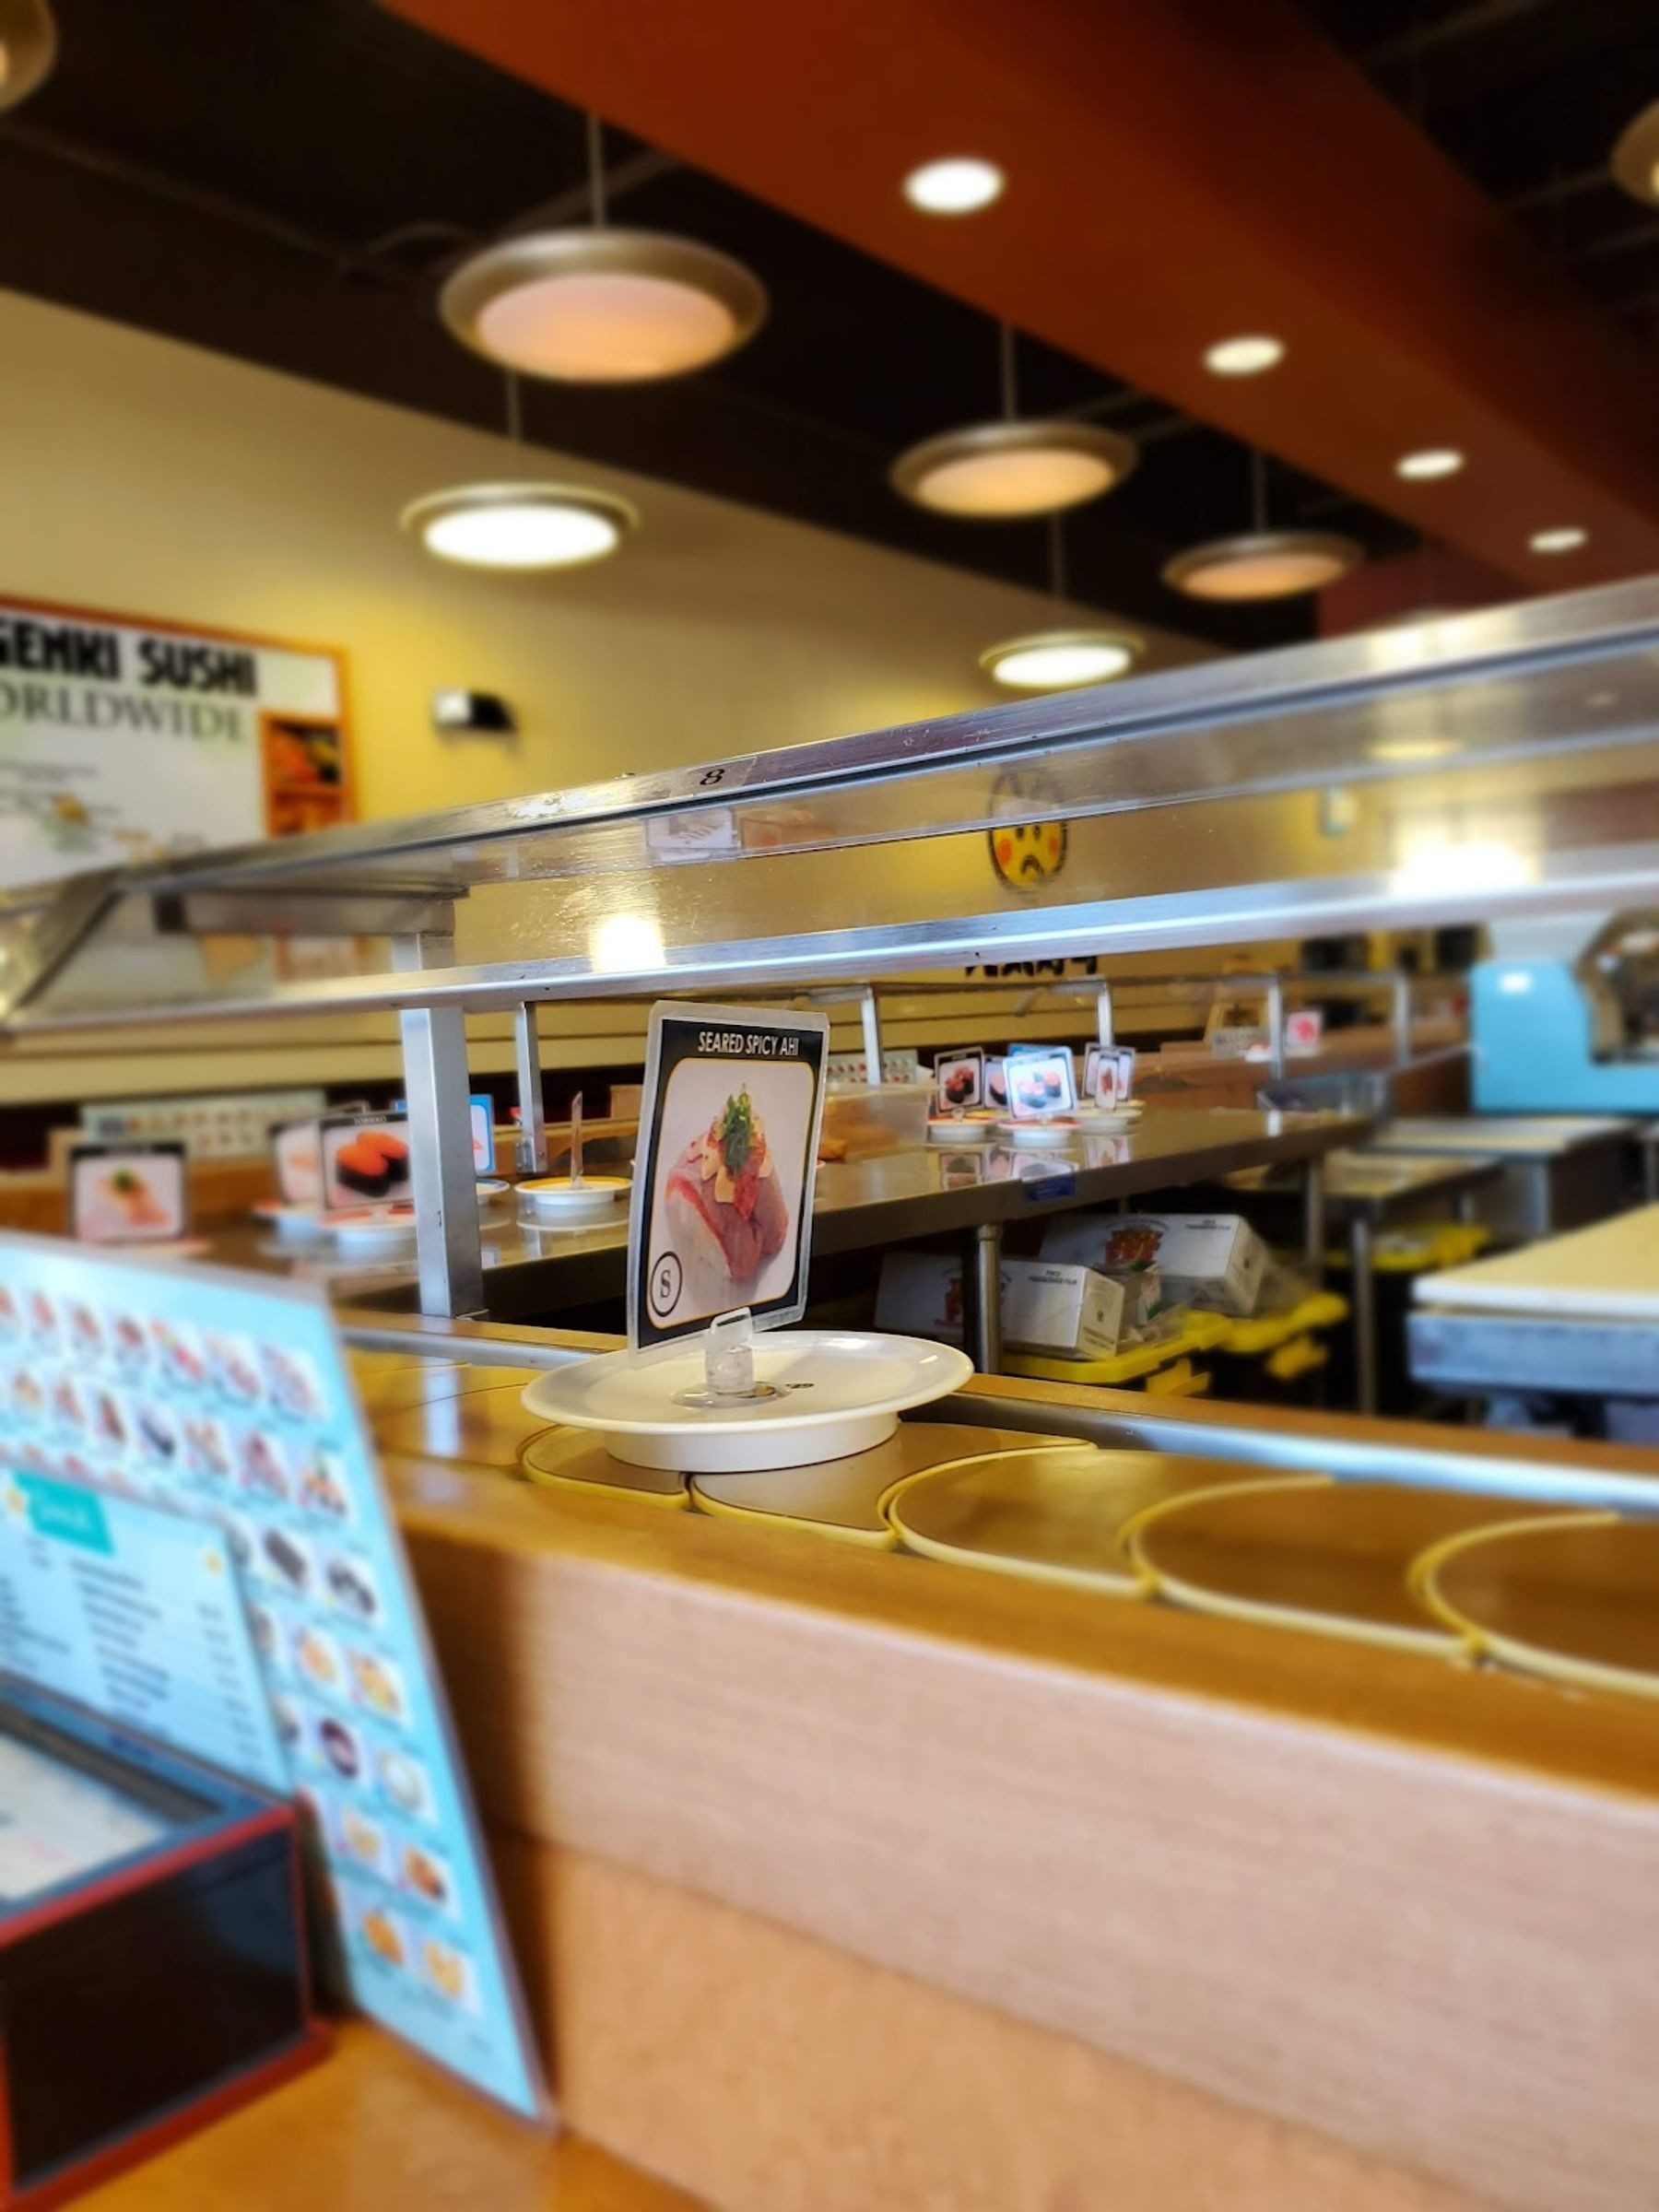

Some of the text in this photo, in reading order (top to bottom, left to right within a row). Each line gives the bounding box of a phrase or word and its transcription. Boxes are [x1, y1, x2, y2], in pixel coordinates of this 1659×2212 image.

[137, 637, 258, 698] SUSHI
[700, 768, 725, 785] 8
[698, 1030, 800, 1056] SEARED SPICY AHI
[660, 1269, 671, 1299] S
